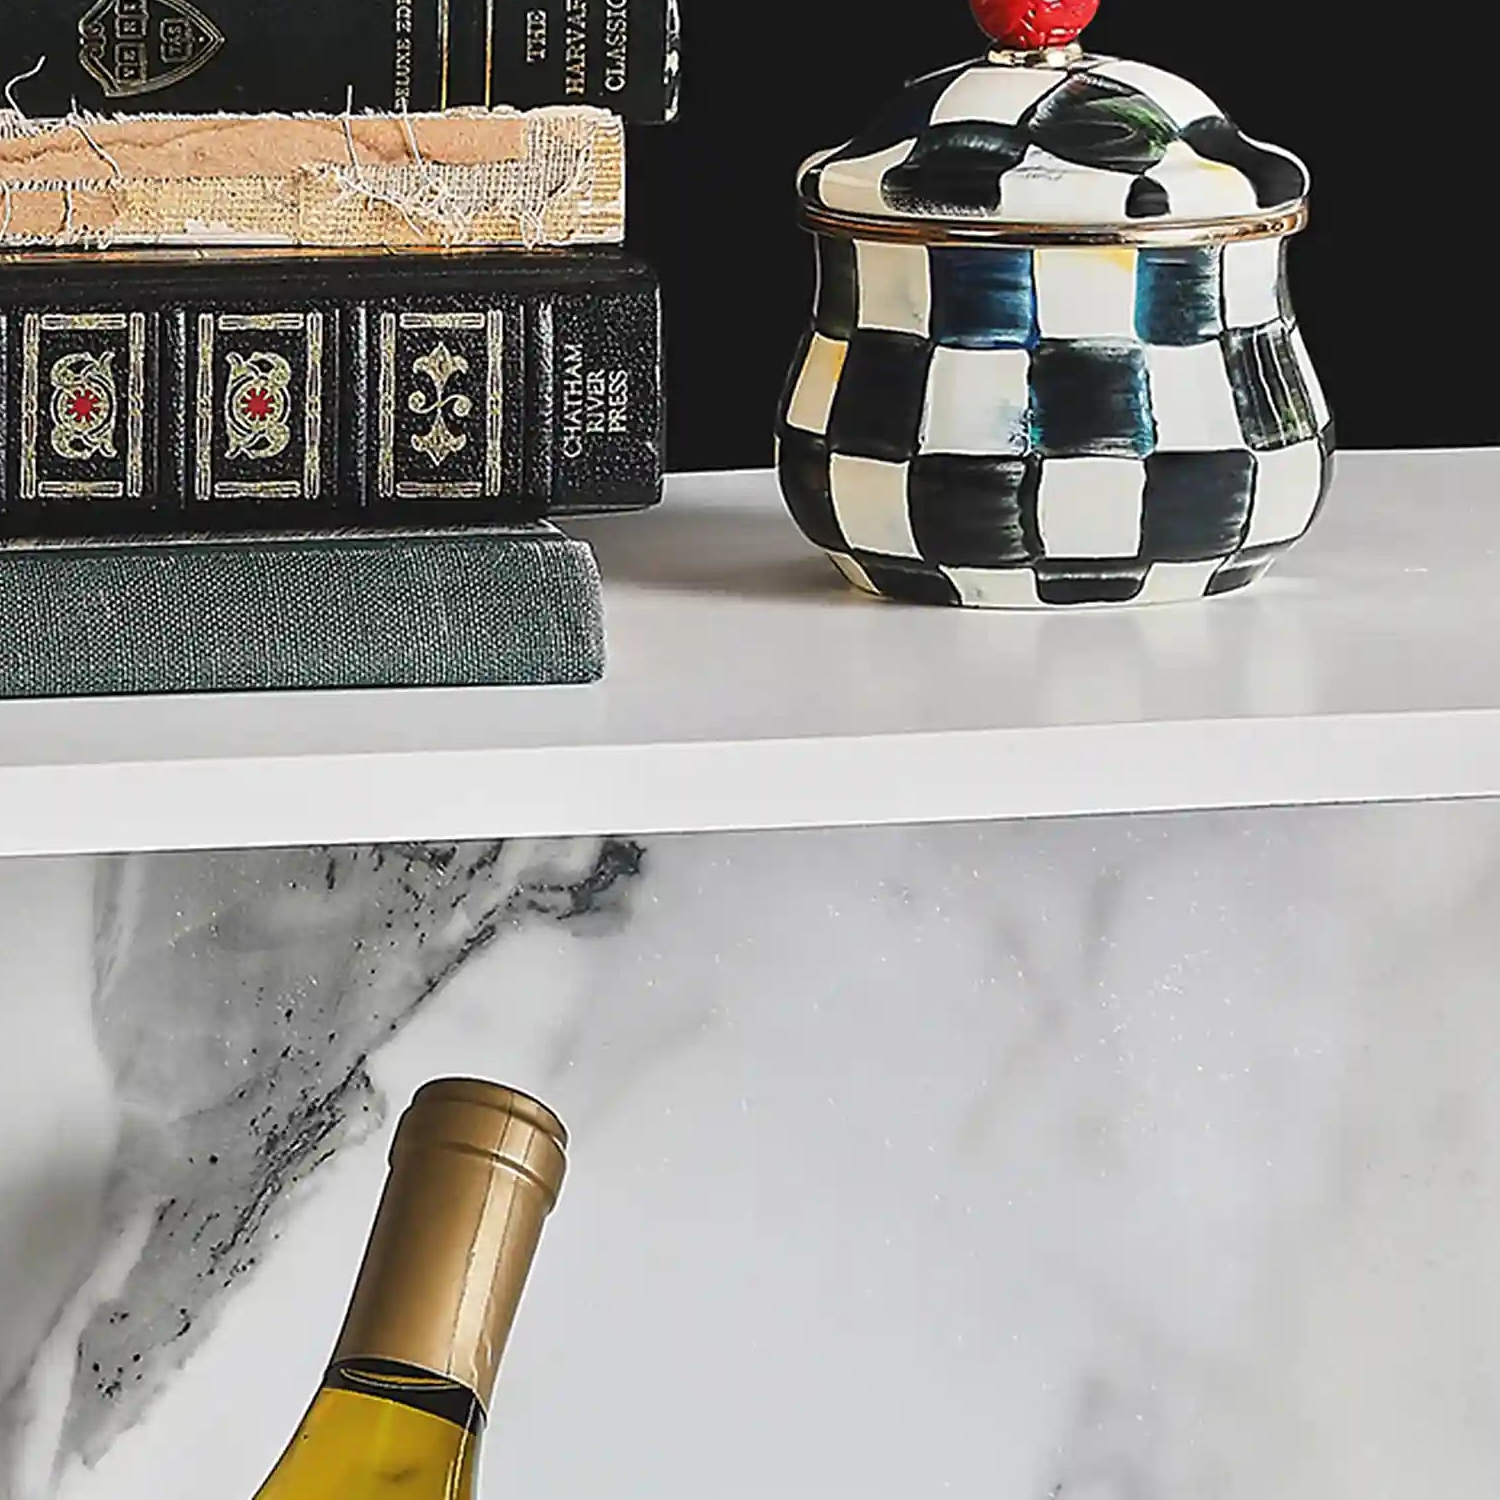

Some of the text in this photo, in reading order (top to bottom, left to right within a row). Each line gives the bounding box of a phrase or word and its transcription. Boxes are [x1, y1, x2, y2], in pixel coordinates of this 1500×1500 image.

[526, 8, 548, 63] THE
[562, 343, 584, 459] CHATHAM
[586, 368, 606, 434] RIVER
[608, 369, 629, 434] PRESS
